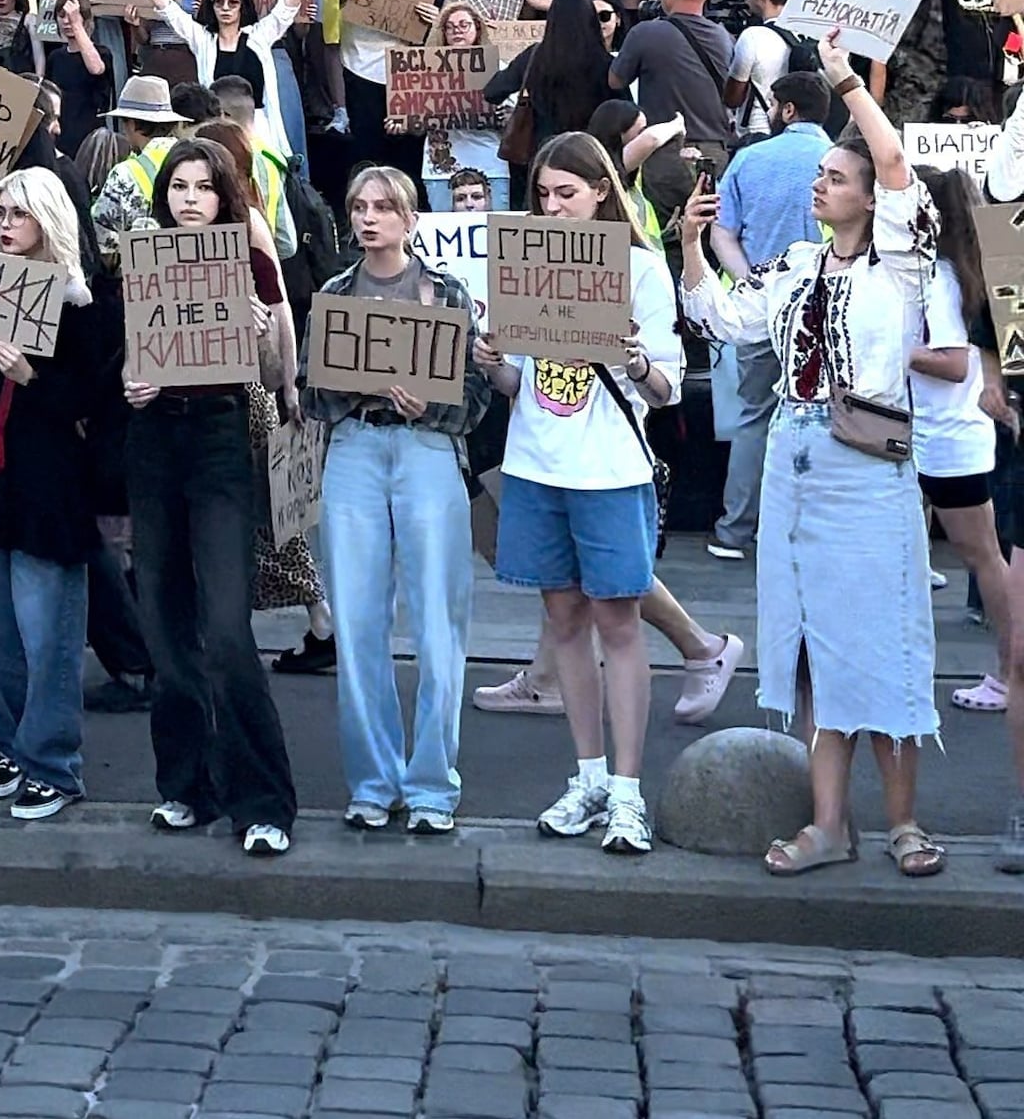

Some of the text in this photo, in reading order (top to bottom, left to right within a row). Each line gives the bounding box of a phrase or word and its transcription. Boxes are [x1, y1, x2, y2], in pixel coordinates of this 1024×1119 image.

[434, 47, 486, 73] ХТО
[391, 72, 465, 91] ПРОТИ
[130, 231, 241, 269] ГРОШІ
[497, 228, 607, 266] ГРОШІ
[125, 261, 252, 303] НА ФРОНТ
[499, 265, 625, 304] ВІЙСЬКУ
[148, 302, 228, 327] А НЕ В
[539, 305, 576, 319] А НЕ
[137, 326, 256, 375] КИШЕНІ
[324, 310, 462, 381] ВЕТО
[497, 324, 627, 348] КОРУПЦІОНЕРАМ
